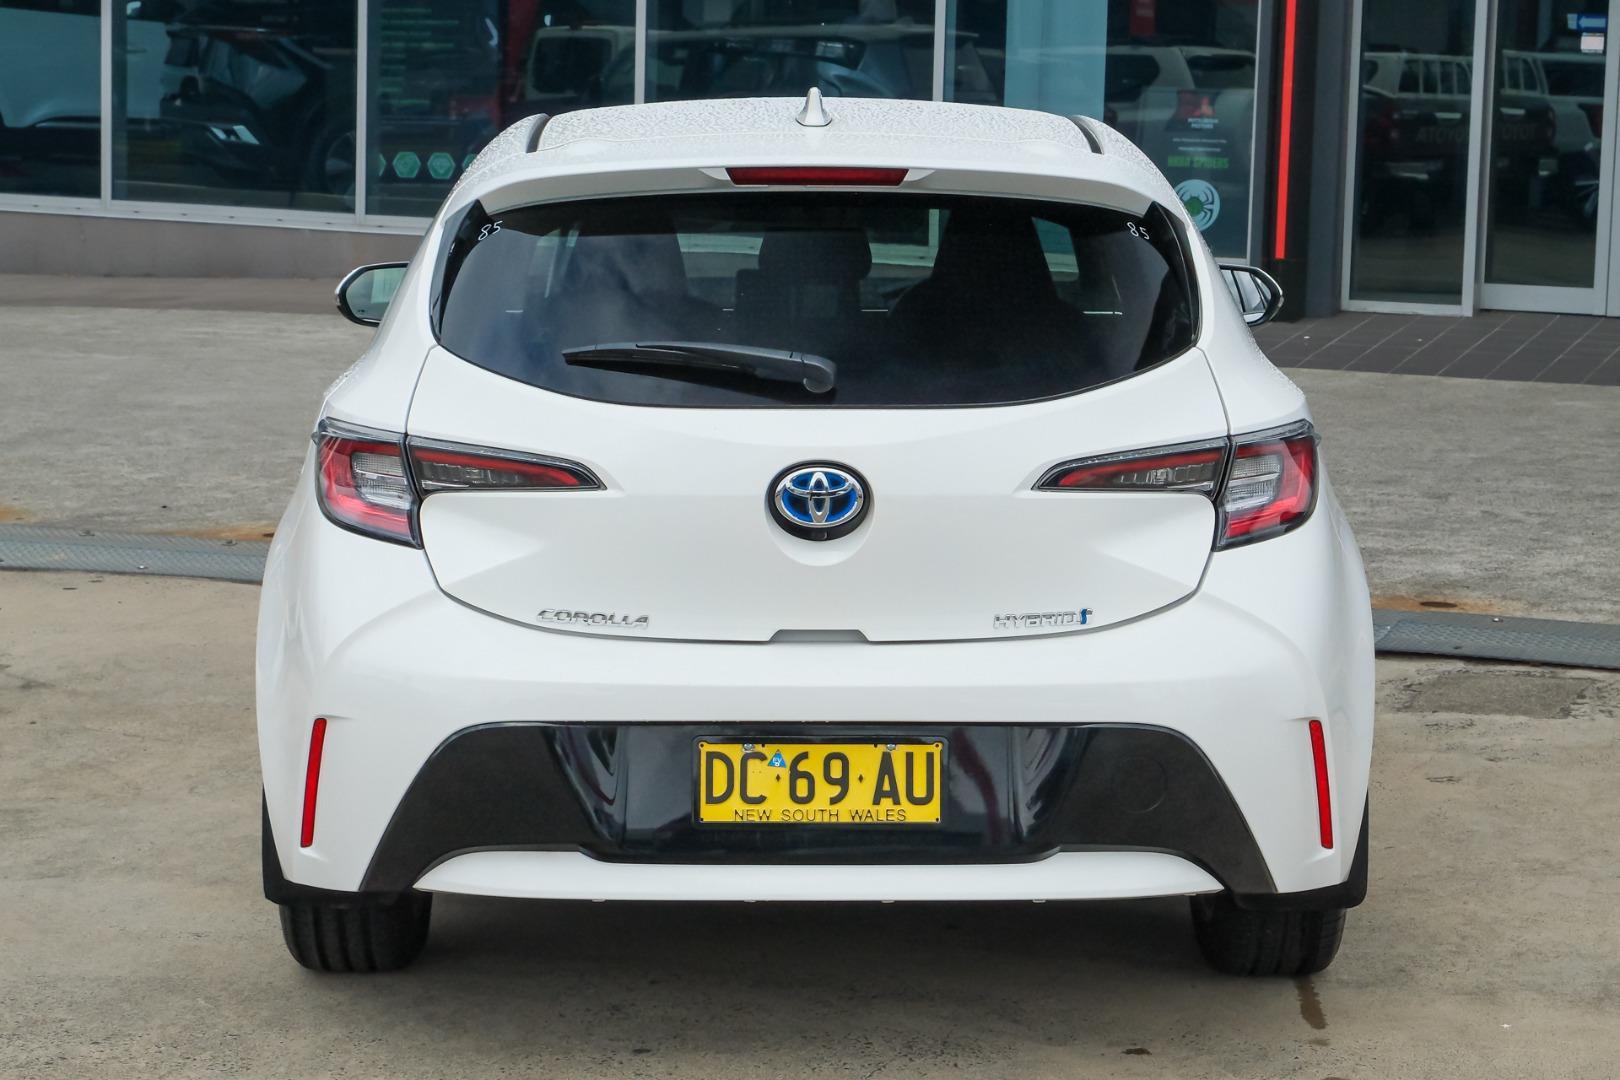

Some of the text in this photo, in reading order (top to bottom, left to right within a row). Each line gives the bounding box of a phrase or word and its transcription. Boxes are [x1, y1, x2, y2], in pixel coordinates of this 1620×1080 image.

[478, 220, 503, 240] 85
[1127, 222, 1150, 240] 85
[538, 608, 649, 629] COROLLA
[993, 611, 1077, 629] HYBRID
[734, 808, 907, 822] NEW SOUTH WALES
